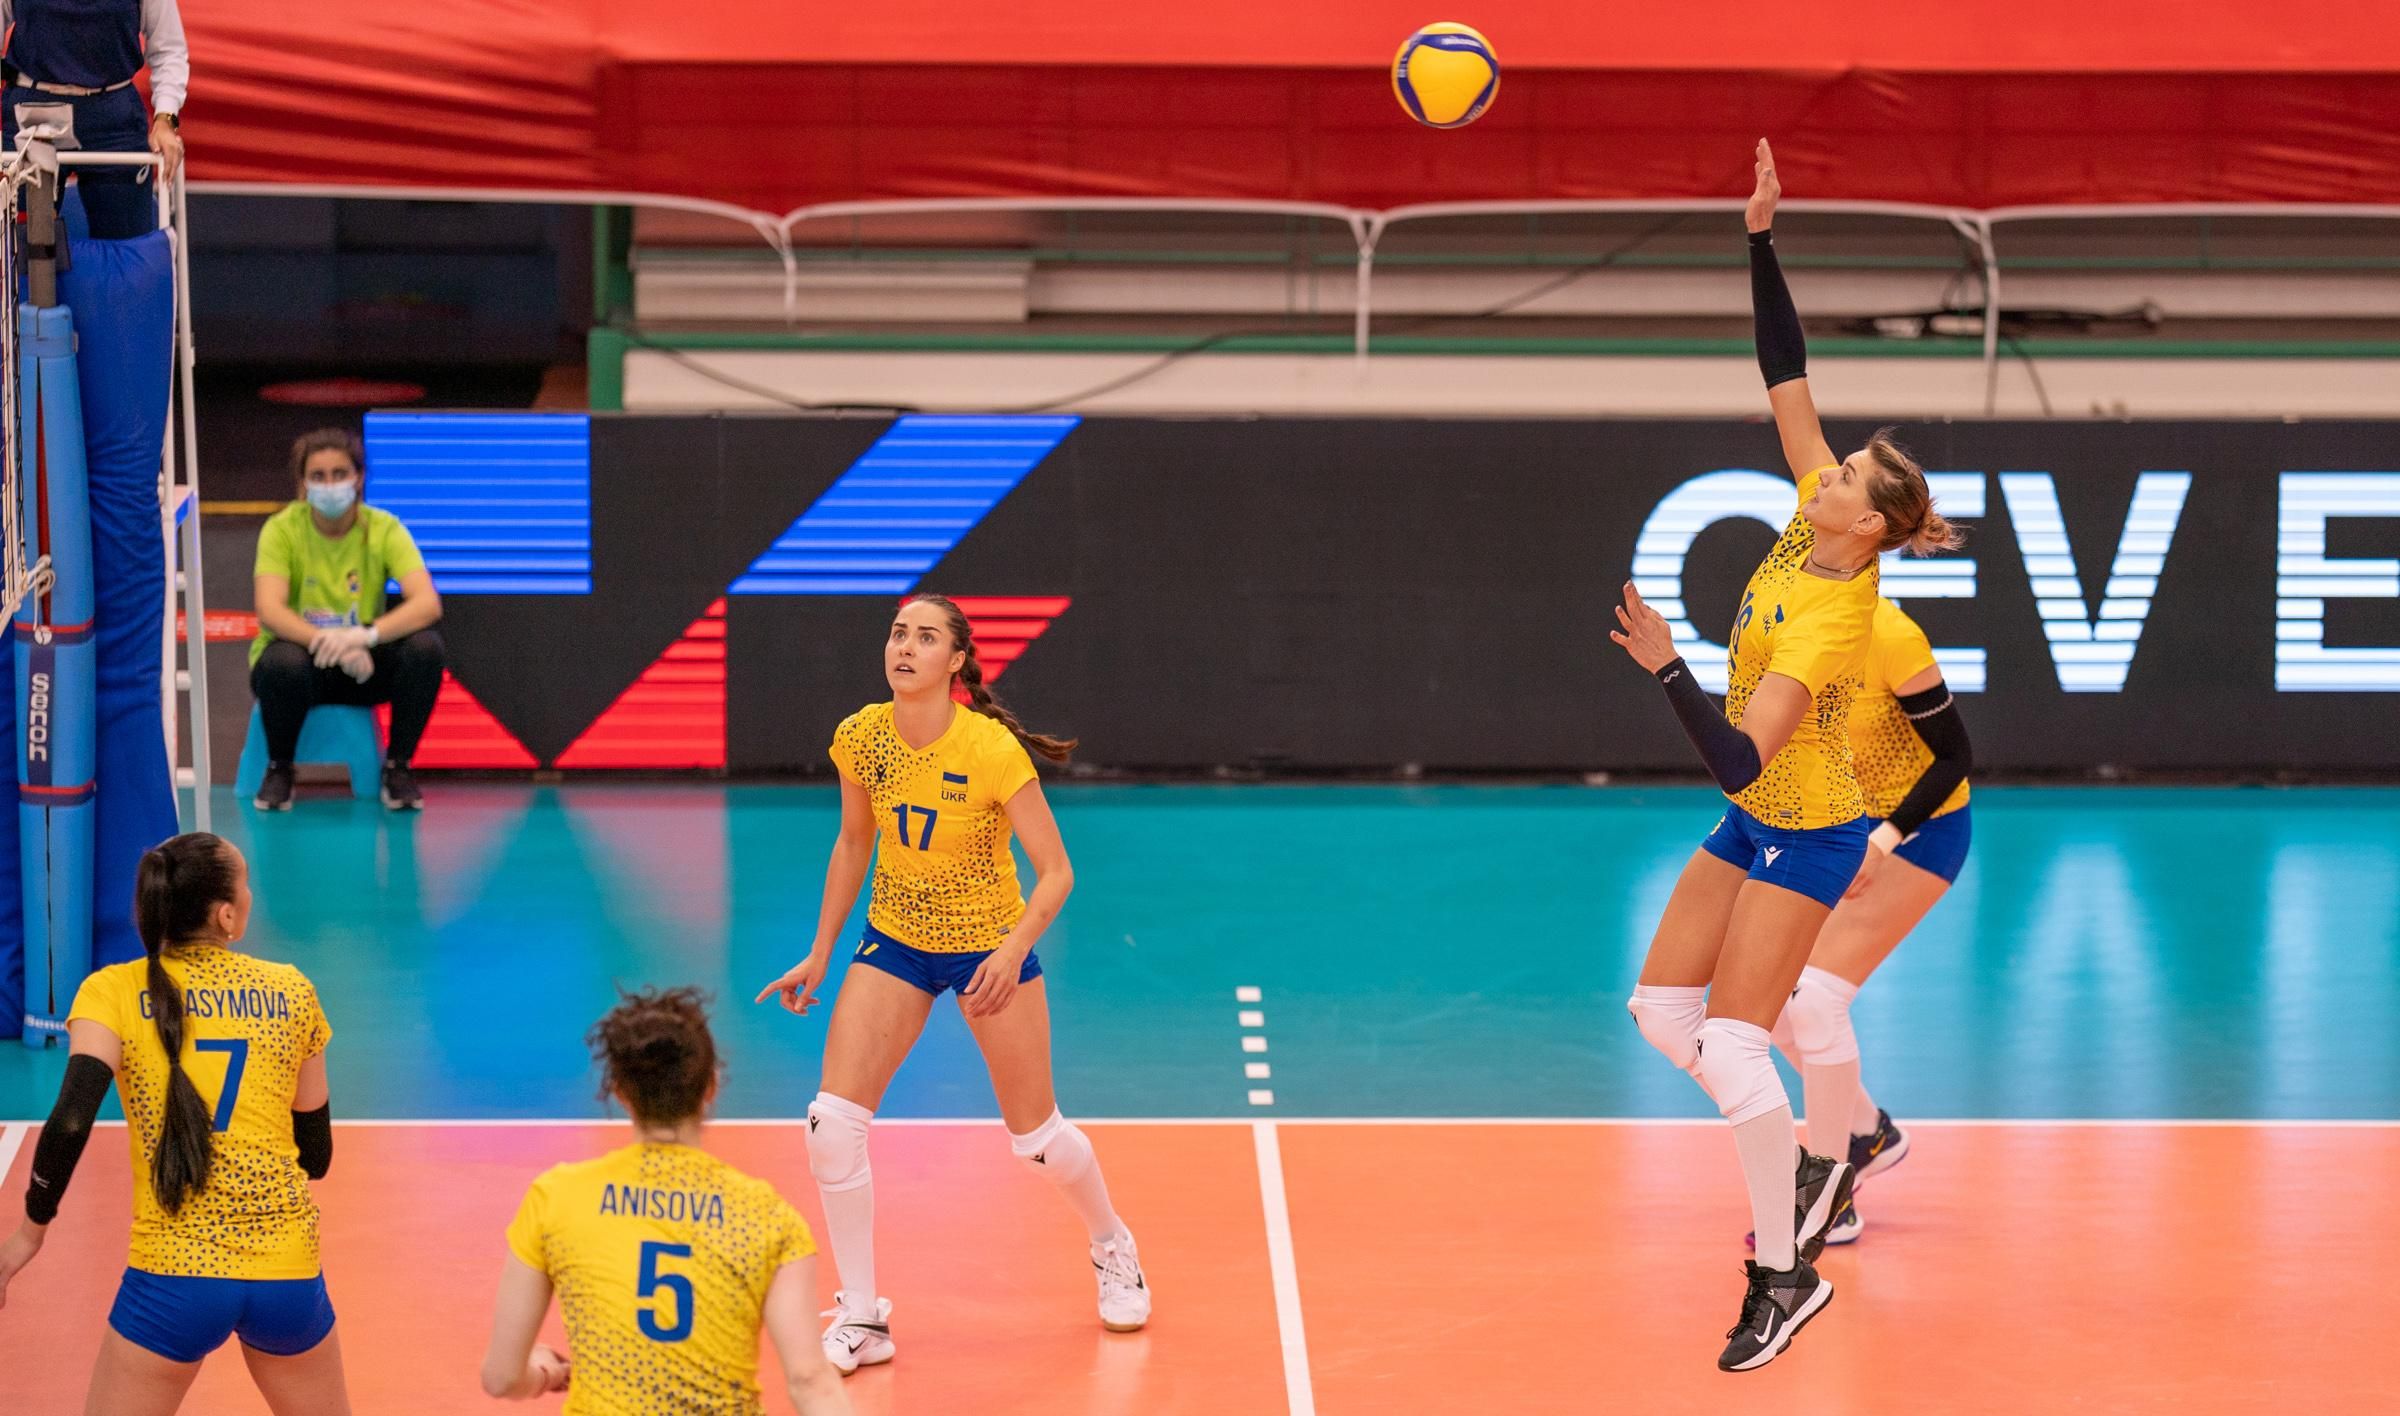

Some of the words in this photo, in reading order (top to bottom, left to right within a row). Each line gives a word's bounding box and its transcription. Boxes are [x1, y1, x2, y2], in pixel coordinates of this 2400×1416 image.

[941, 790, 967, 803] UKR
[892, 803, 938, 851] 17
[140, 988, 289, 1021] GASYMOVA
[195, 1039, 249, 1132] 7
[600, 1183, 724, 1225] ANISOVA
[637, 1241, 694, 1343] 5
